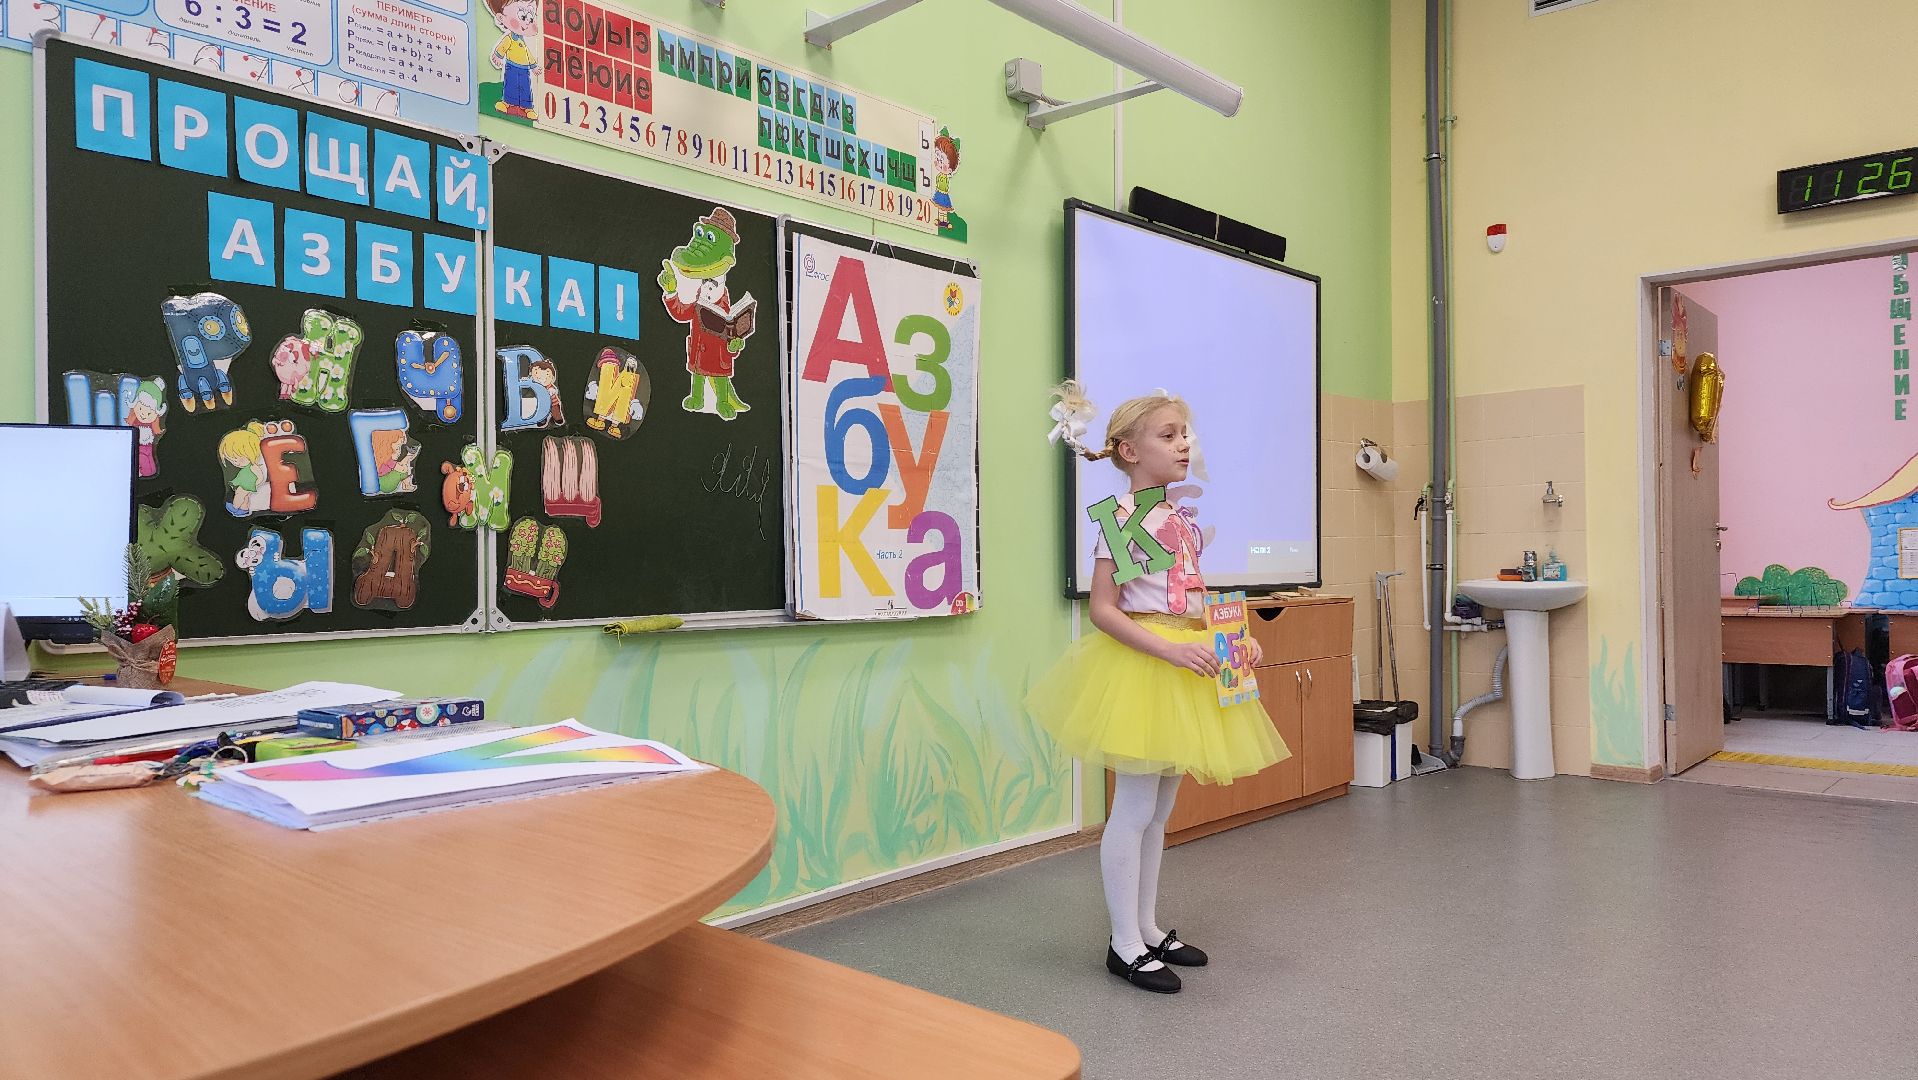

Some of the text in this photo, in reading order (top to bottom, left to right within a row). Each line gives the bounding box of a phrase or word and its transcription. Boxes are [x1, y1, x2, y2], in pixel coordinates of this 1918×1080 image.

[236, 6, 252, 30] 3
[291, 22, 307, 46] 2
[351, 4, 457, 45] (сумма длин сторон)
[376, 0, 434, 24] ПЕРИМЕТР
[92, 83, 487, 226] ПРОЩАЙ,
[545, 92, 931, 224] 0 1 2 3 4 5 6 7 8 9 10 11 12 13 14 15 16 17 18 19 20
[221, 217, 626, 322] АЗБУКА!
[1213, 605, 1243, 621] АЗБУКА
